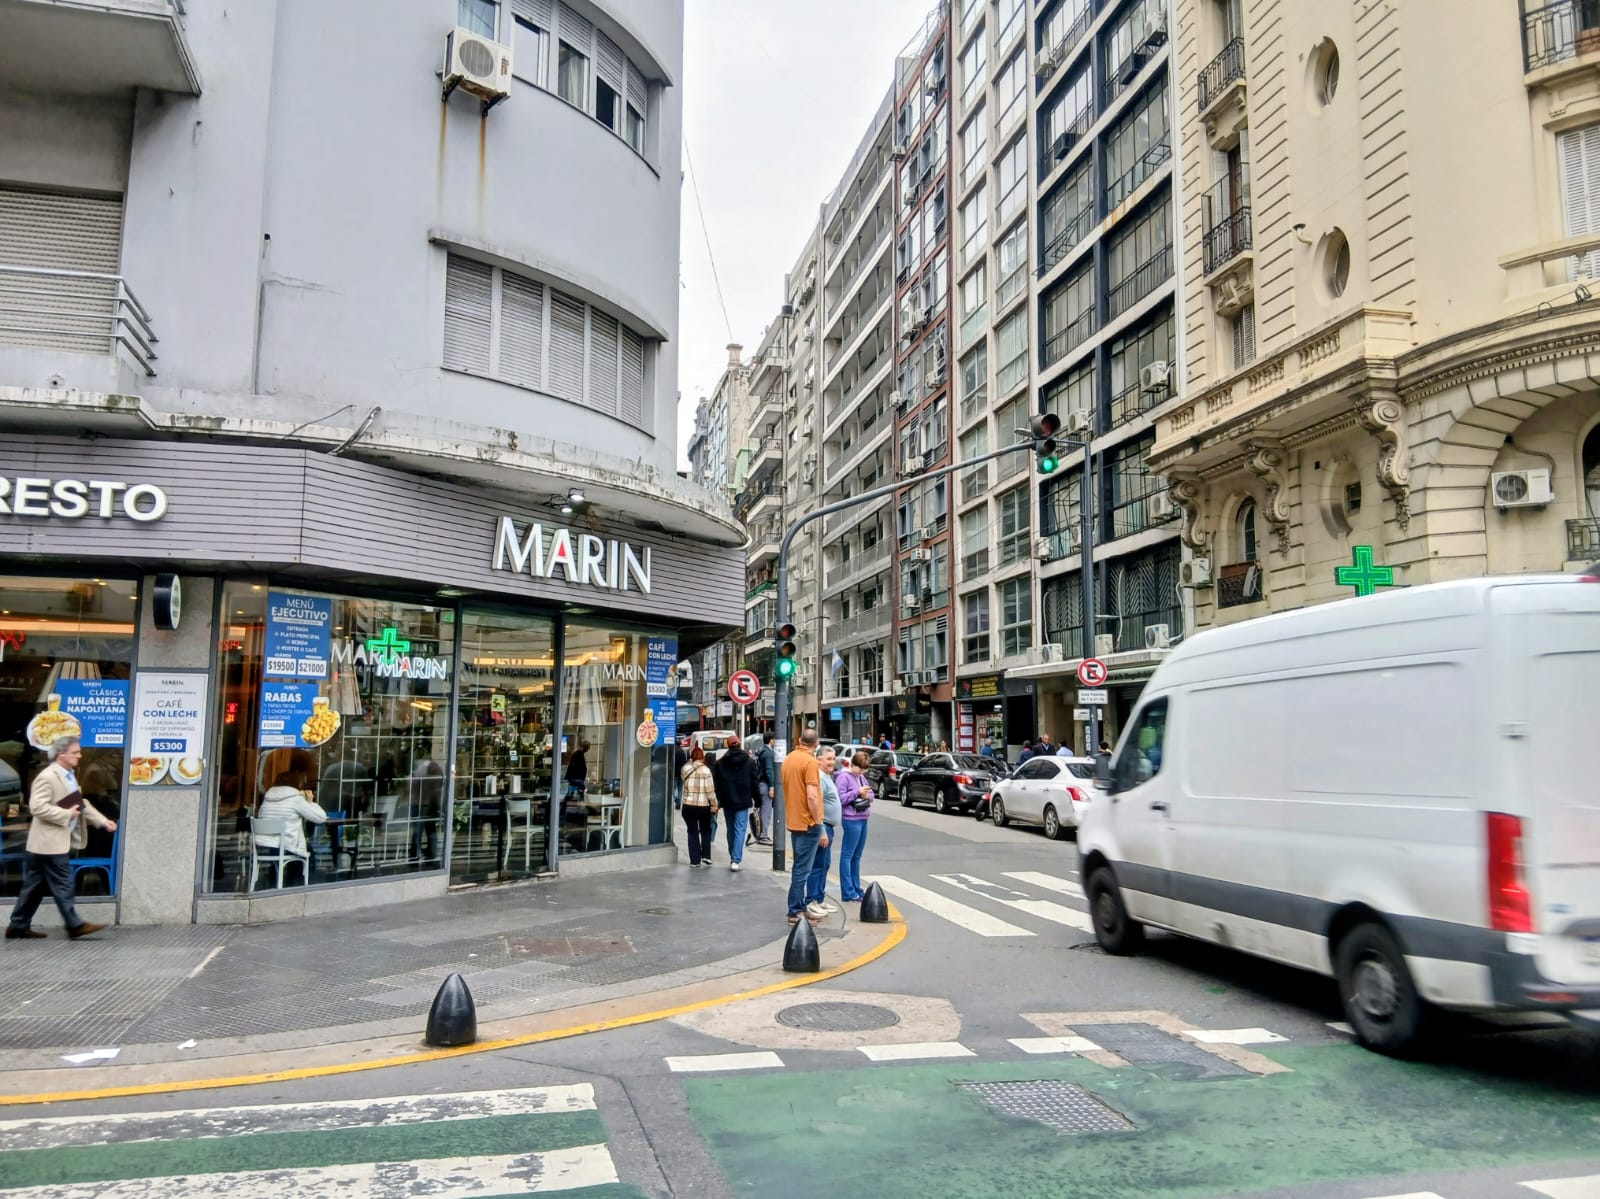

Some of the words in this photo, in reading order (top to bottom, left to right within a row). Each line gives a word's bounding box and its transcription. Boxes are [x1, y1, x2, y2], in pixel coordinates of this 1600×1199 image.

[491, 515, 651, 595] MARIN
[286, 598, 314, 610] MENÚ
[271, 606, 328, 620] EJECUTIVO
[648, 641, 666, 652] CAFÉ
[267, 661, 295, 672] $19500
[299, 662, 325, 673] $21000
[376, 655, 447, 680] MARIN
[602, 664, 647, 681] MARIN
[89, 688, 124, 697] CLÁSICA
[265, 692, 302, 703] RABAS
[67, 697, 126, 706] MILANESA
[156, 698, 183, 709] CAFÉ
[143, 710, 166, 718] CON
[167, 710, 199, 718] LECHE
[153, 742, 183, 751] $5300
